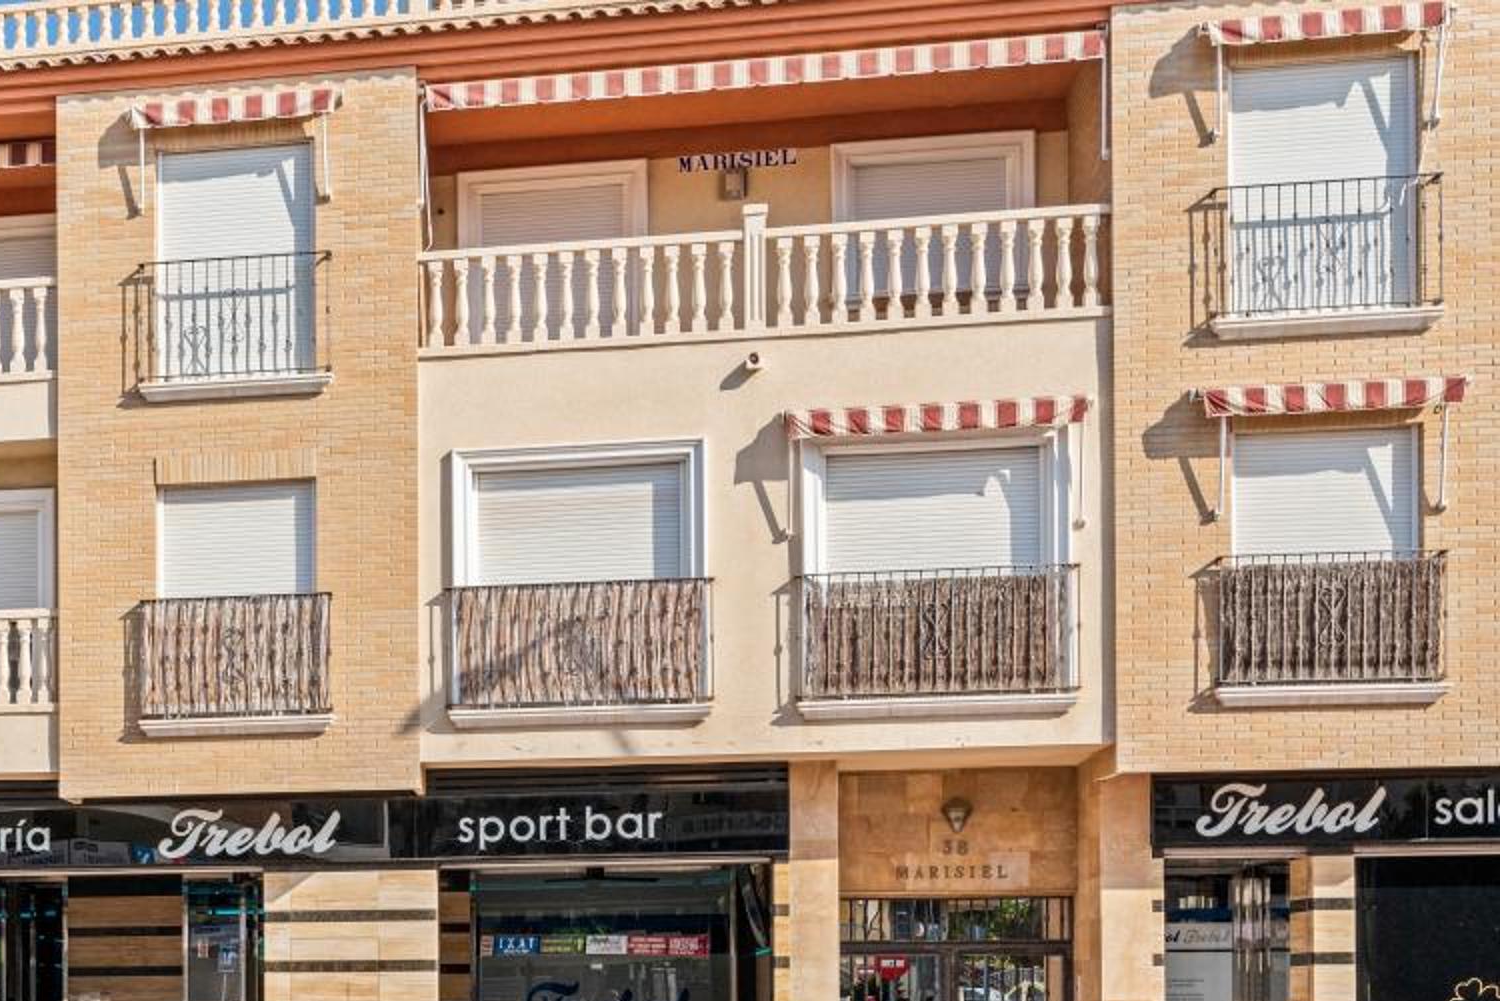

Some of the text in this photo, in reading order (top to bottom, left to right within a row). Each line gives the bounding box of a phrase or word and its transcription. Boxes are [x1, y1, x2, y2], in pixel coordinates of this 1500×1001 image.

[679, 148, 797, 172] MARISIEL
[1195, 783, 1387, 837] Trebol
[1434, 789, 1500, 825] sal
[157, 808, 341, 860] Trebol
[457, 807, 571, 850] sport
[584, 806, 663, 841] bar
[895, 864, 1008, 881] MARISIEL
